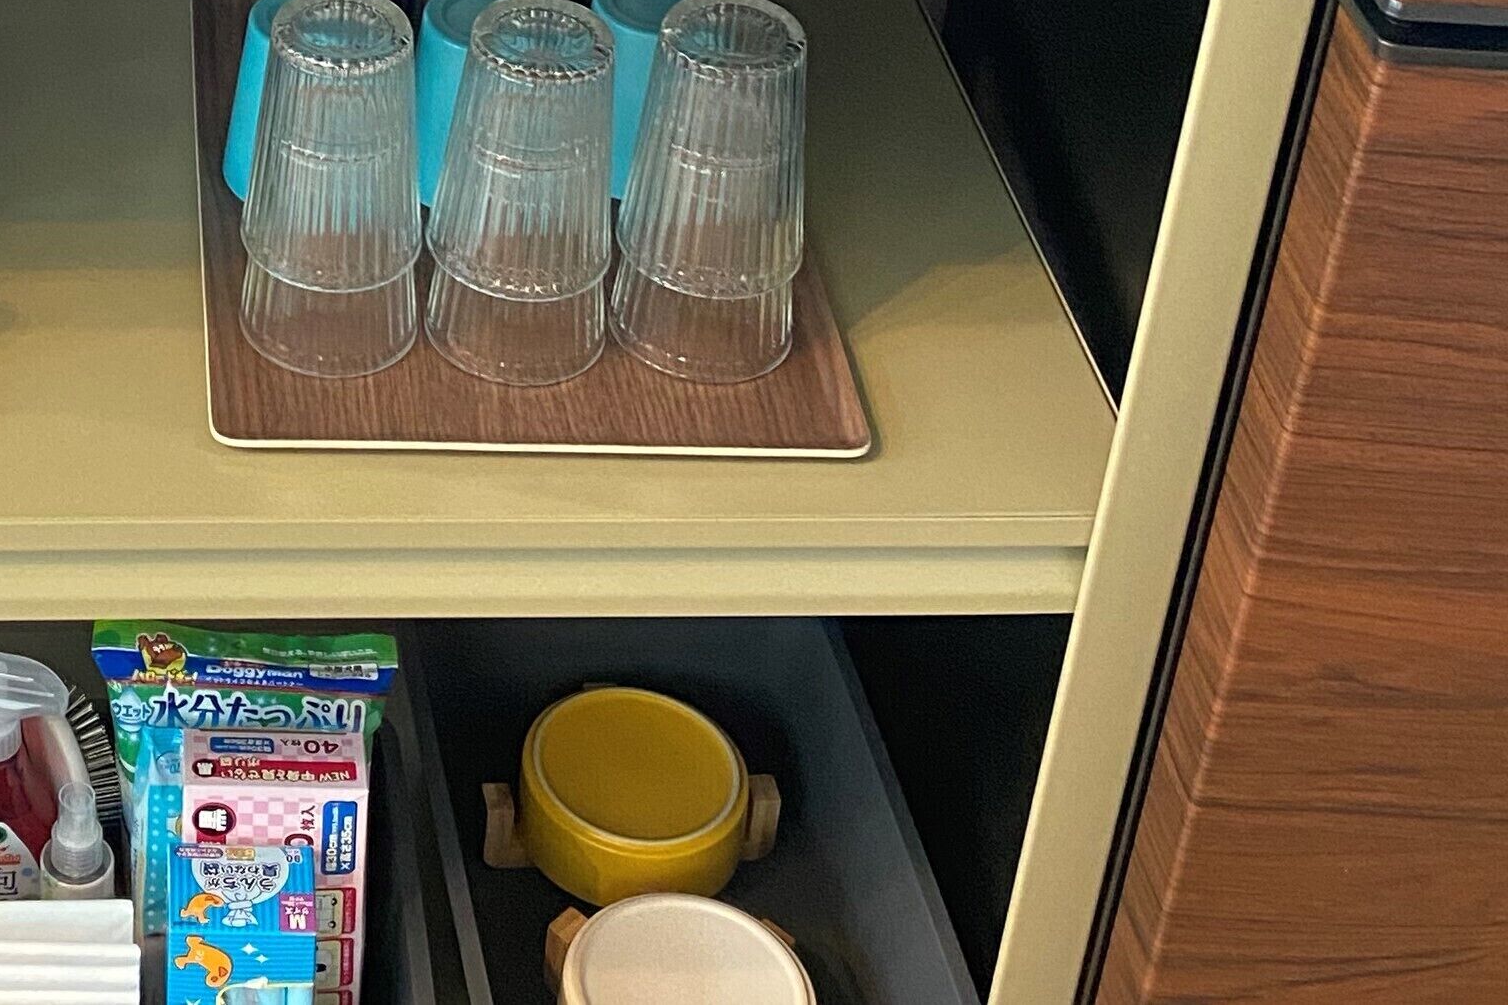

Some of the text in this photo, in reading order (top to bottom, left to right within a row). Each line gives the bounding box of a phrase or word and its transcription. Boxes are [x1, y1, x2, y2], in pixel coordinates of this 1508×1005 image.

[318, 770, 351, 782] NEW
[206, 876, 277, 891] うんちが
[289, 914, 307, 930] M
